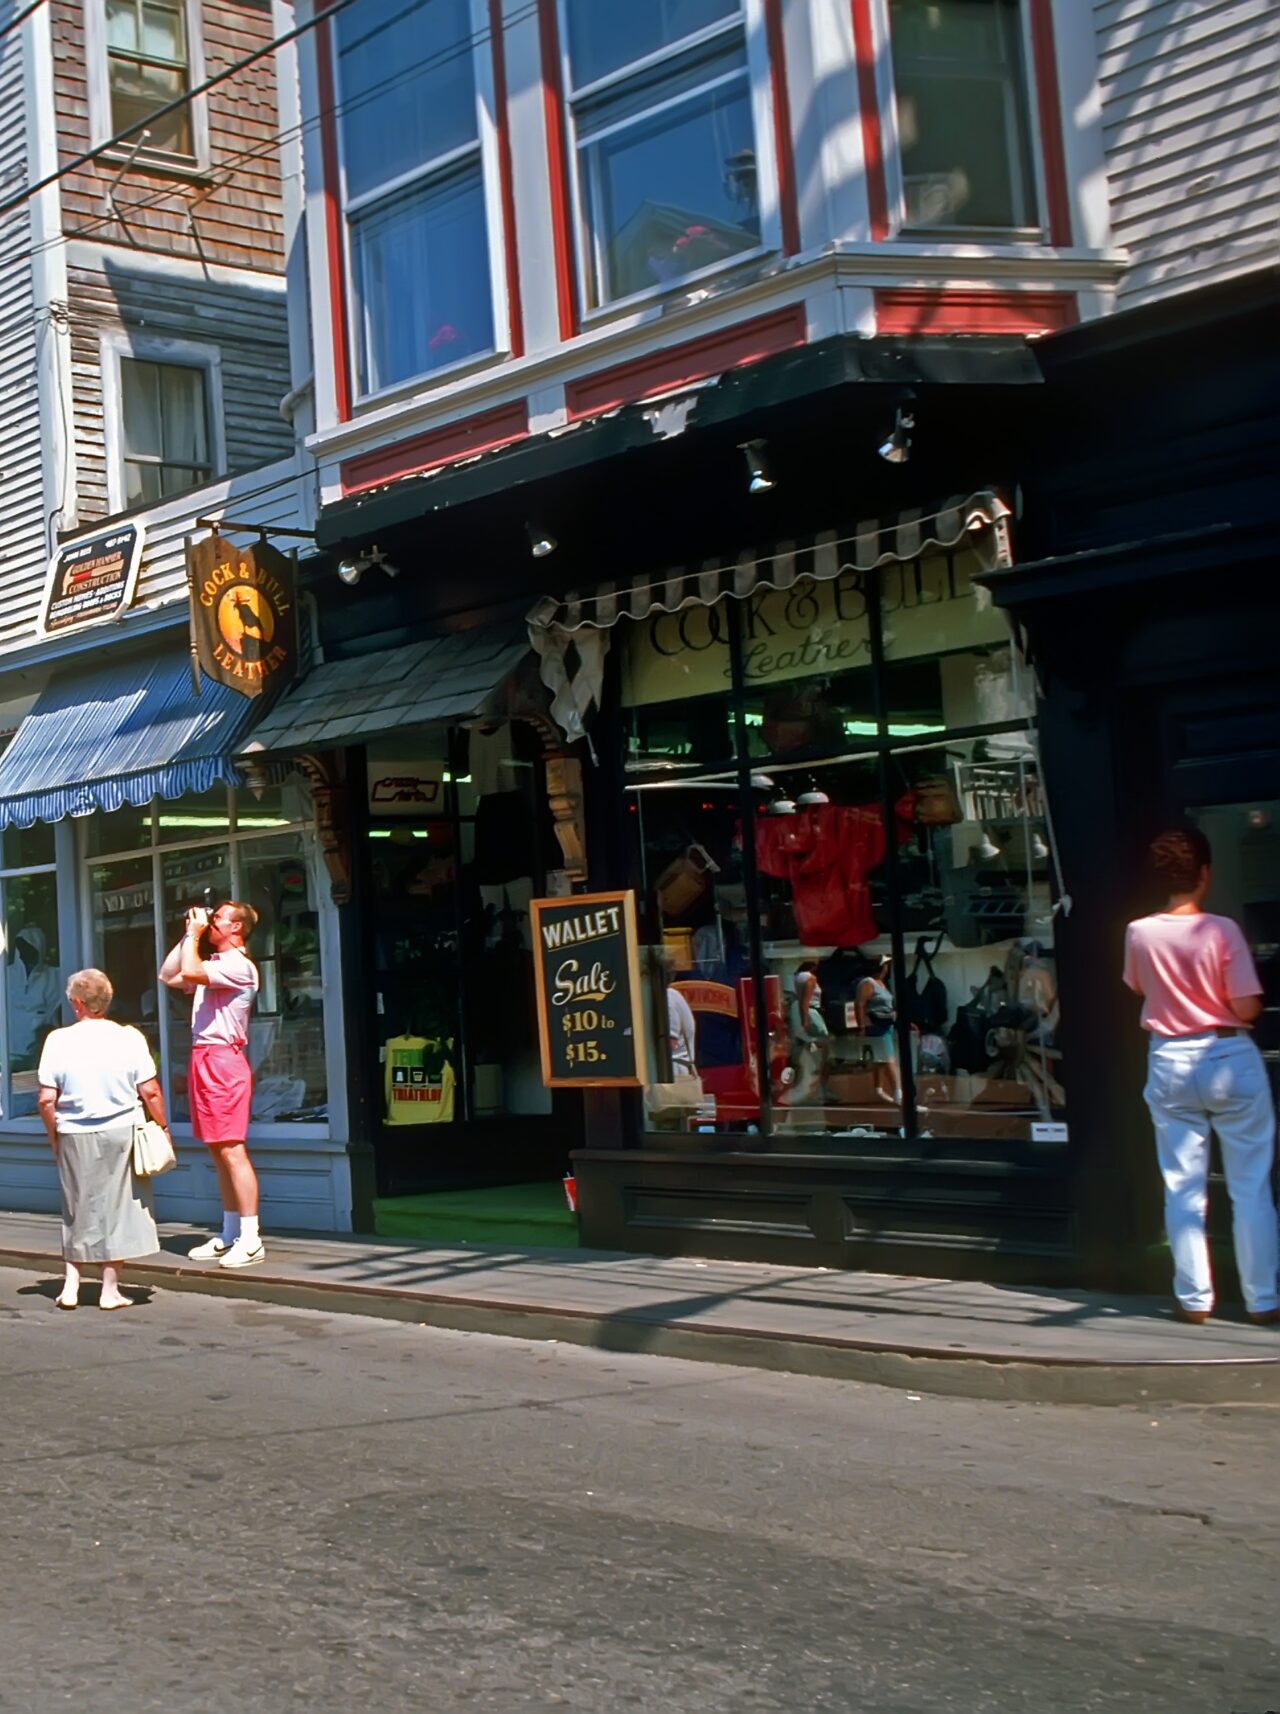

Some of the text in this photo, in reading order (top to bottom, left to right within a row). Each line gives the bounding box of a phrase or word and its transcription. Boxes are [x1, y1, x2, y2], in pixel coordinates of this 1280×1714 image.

[68, 571, 121, 595] CONSTRUCTION
[200, 562, 291, 617] COCK & BULL
[650, 549, 976, 657] COCK & BULL
[212, 643, 288, 679] LEATHER
[723, 636, 896, 679] Leather
[543, 907, 620, 948] WALLET
[552, 959, 616, 1005] Sale
[562, 1009, 615, 1037] $10 to
